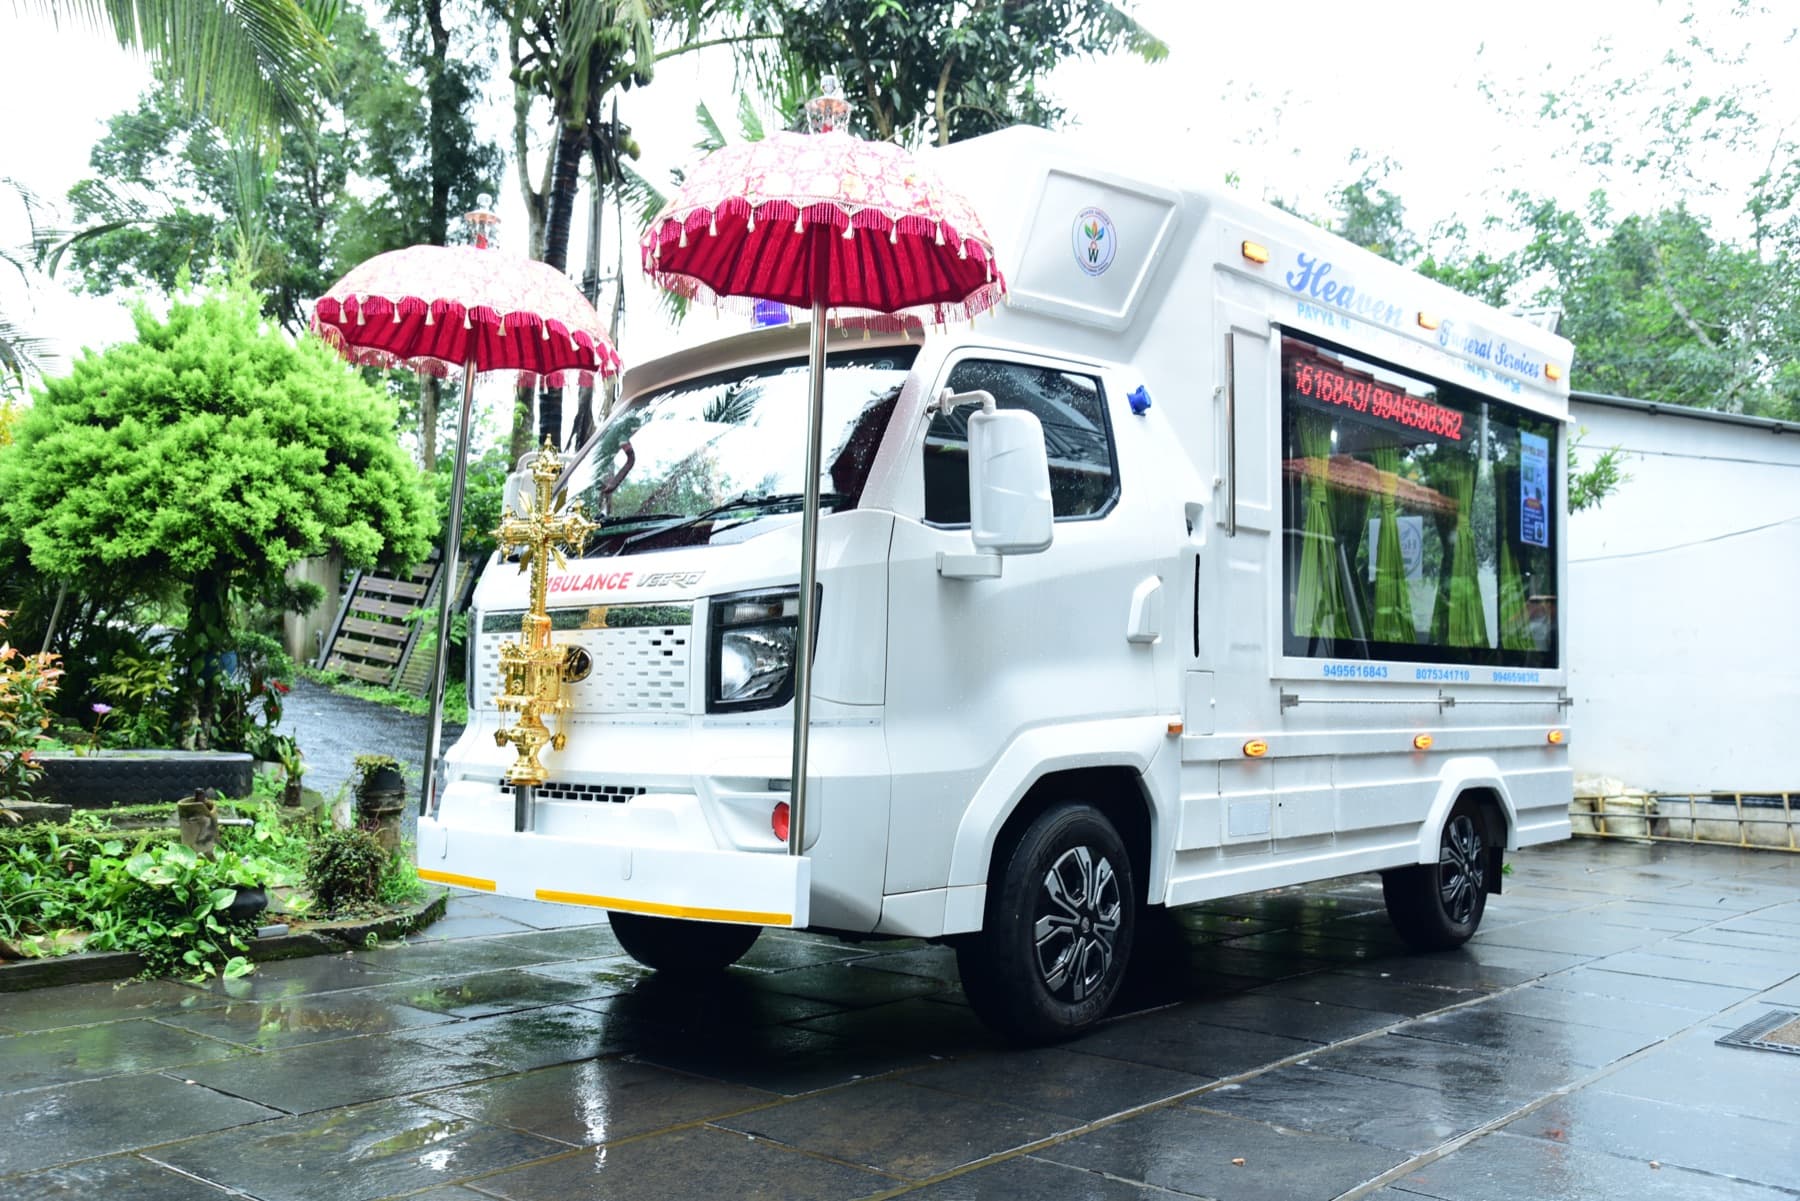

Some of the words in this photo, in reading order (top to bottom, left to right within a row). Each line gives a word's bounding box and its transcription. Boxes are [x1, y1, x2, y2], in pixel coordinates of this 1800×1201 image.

[1286, 252, 1403, 327] Heaven
[1439, 319, 1493, 360] Funeral
[1494, 342, 1540, 378] Services
[637, 570, 706, 588] VEERO
[1323, 664, 1388, 678] 9495616843
[1416, 668, 1470, 681] 8075341710
